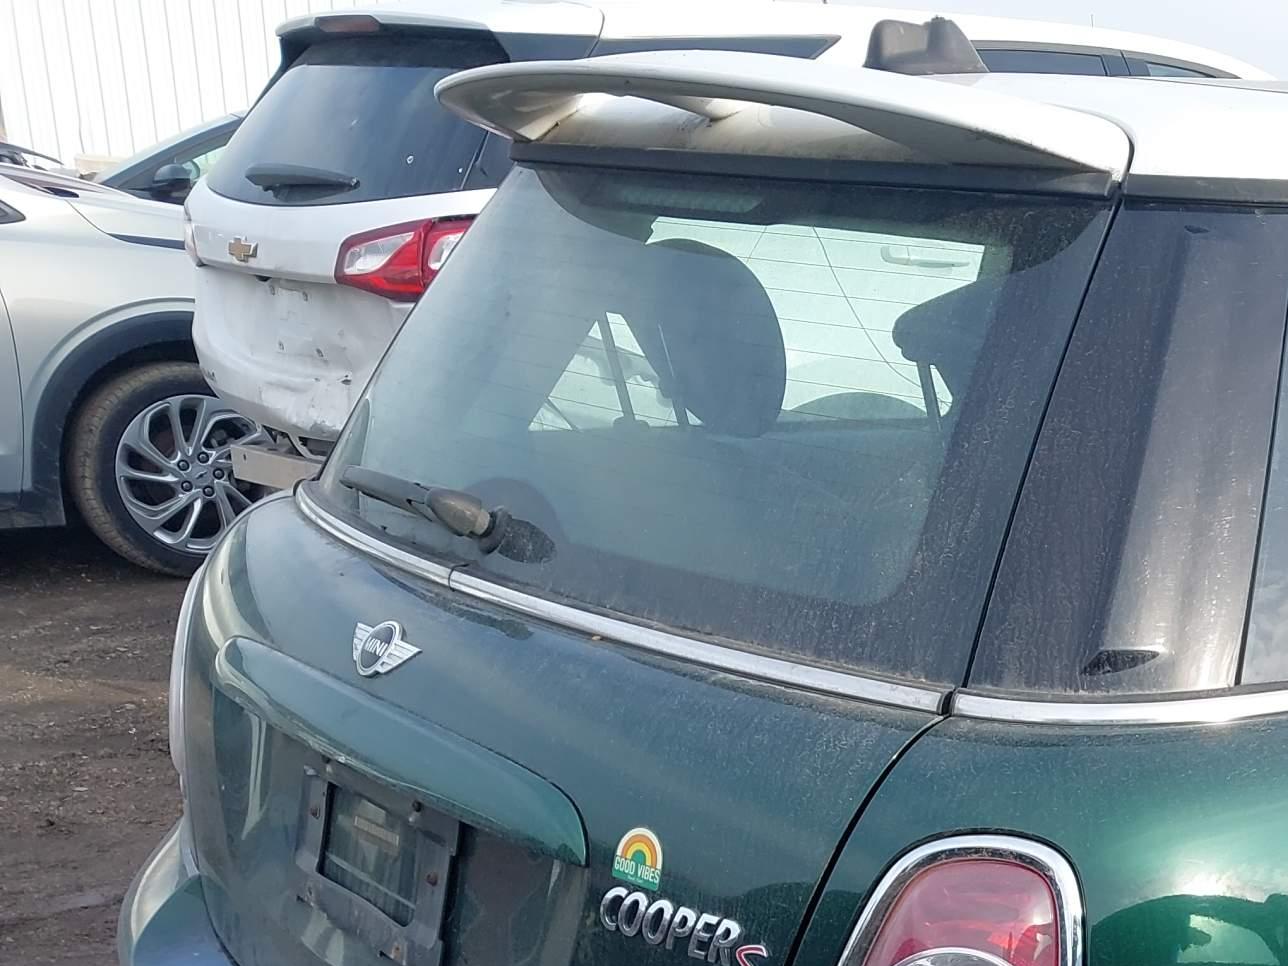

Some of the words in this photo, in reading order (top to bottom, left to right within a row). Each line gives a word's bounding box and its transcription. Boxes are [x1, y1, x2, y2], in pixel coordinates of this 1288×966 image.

[364, 636, 388, 657] MINI
[614, 856, 636, 875] GOOD
[637, 863, 661, 884] VIBES
